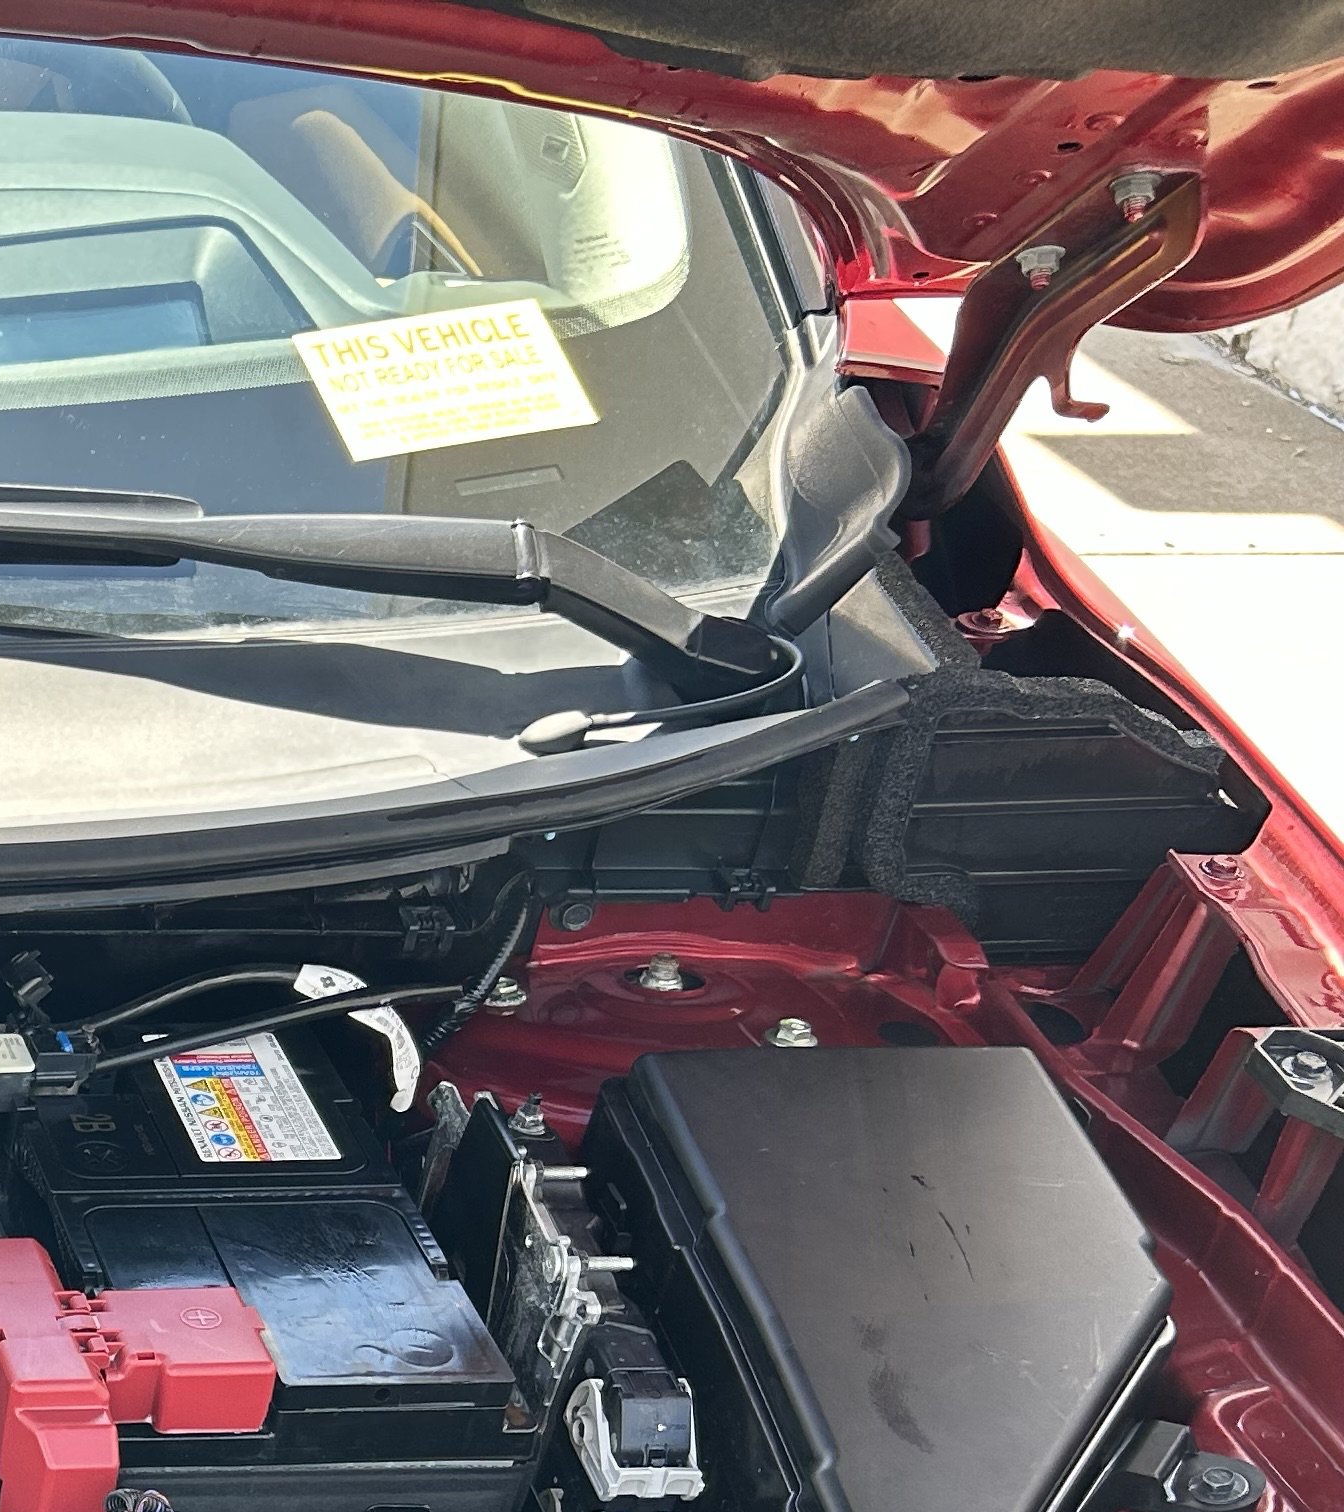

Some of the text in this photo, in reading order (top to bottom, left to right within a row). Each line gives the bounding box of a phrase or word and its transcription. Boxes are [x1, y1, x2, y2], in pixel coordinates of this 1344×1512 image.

[312, 314, 530, 368] THIS VEHICLE
[328, 344, 543, 393] NOT READY FOR SALE
[176, 1096, 196, 1126] NISSAN
[191, 1128, 213, 1159] RENAULT
